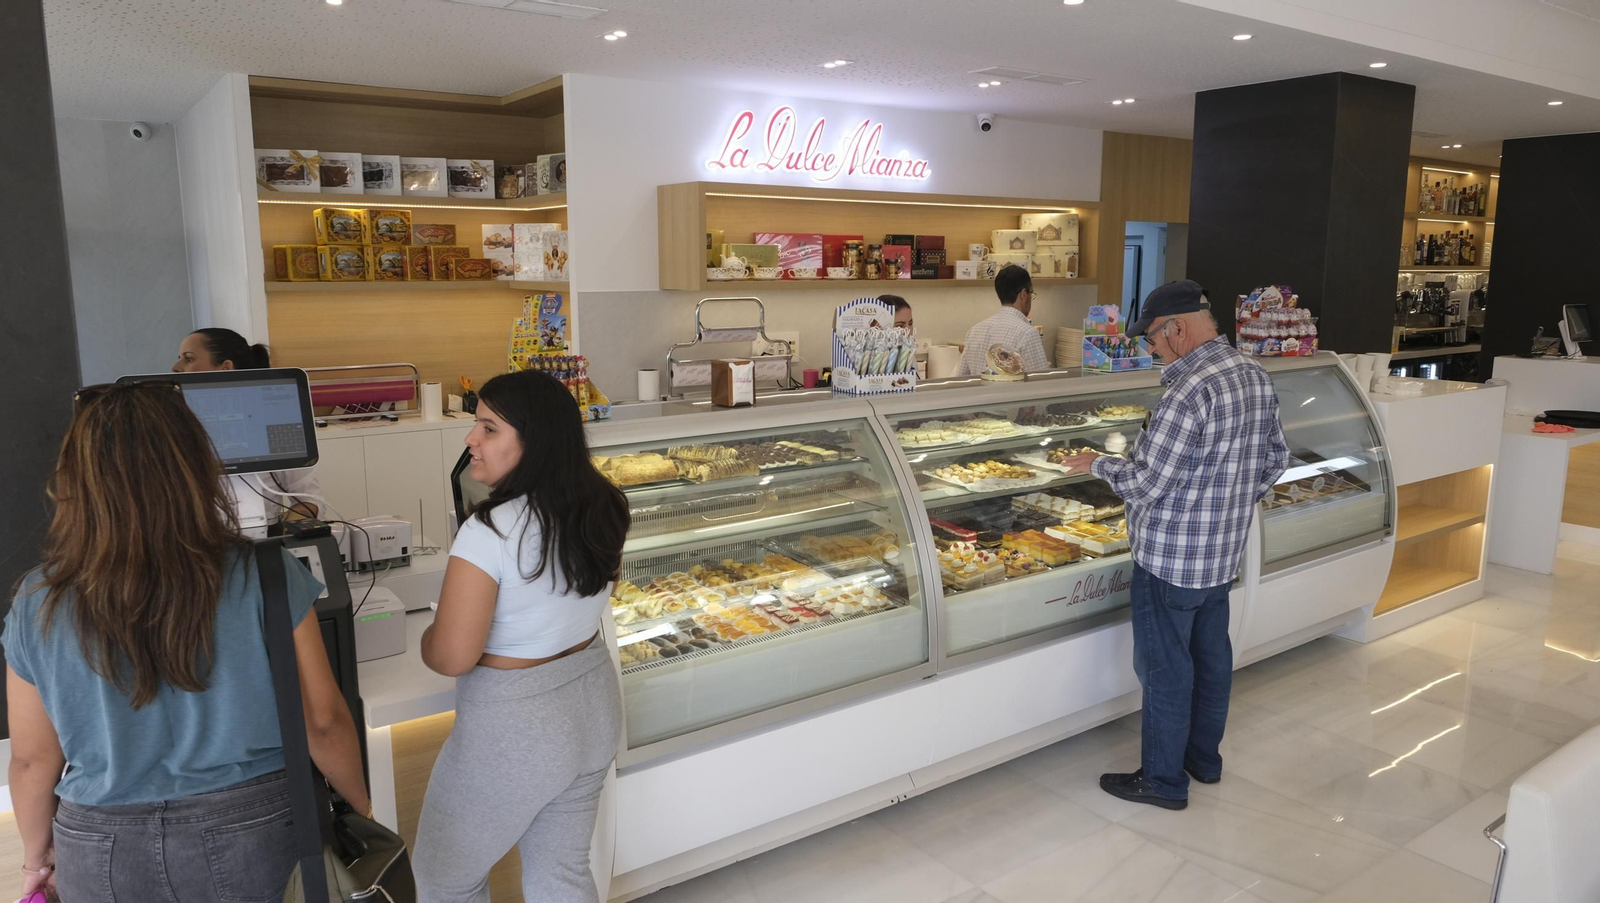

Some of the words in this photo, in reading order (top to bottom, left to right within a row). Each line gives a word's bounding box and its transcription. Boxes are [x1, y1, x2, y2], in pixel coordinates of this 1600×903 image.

[708, 110, 752, 169] La
[756, 104, 837, 171] Dulce
[855, 307, 877, 315] LACASA
[1066, 580, 1080, 607] La
[1079, 573, 1106, 603] Dulce
[1099, 568, 1132, 601] Alian
